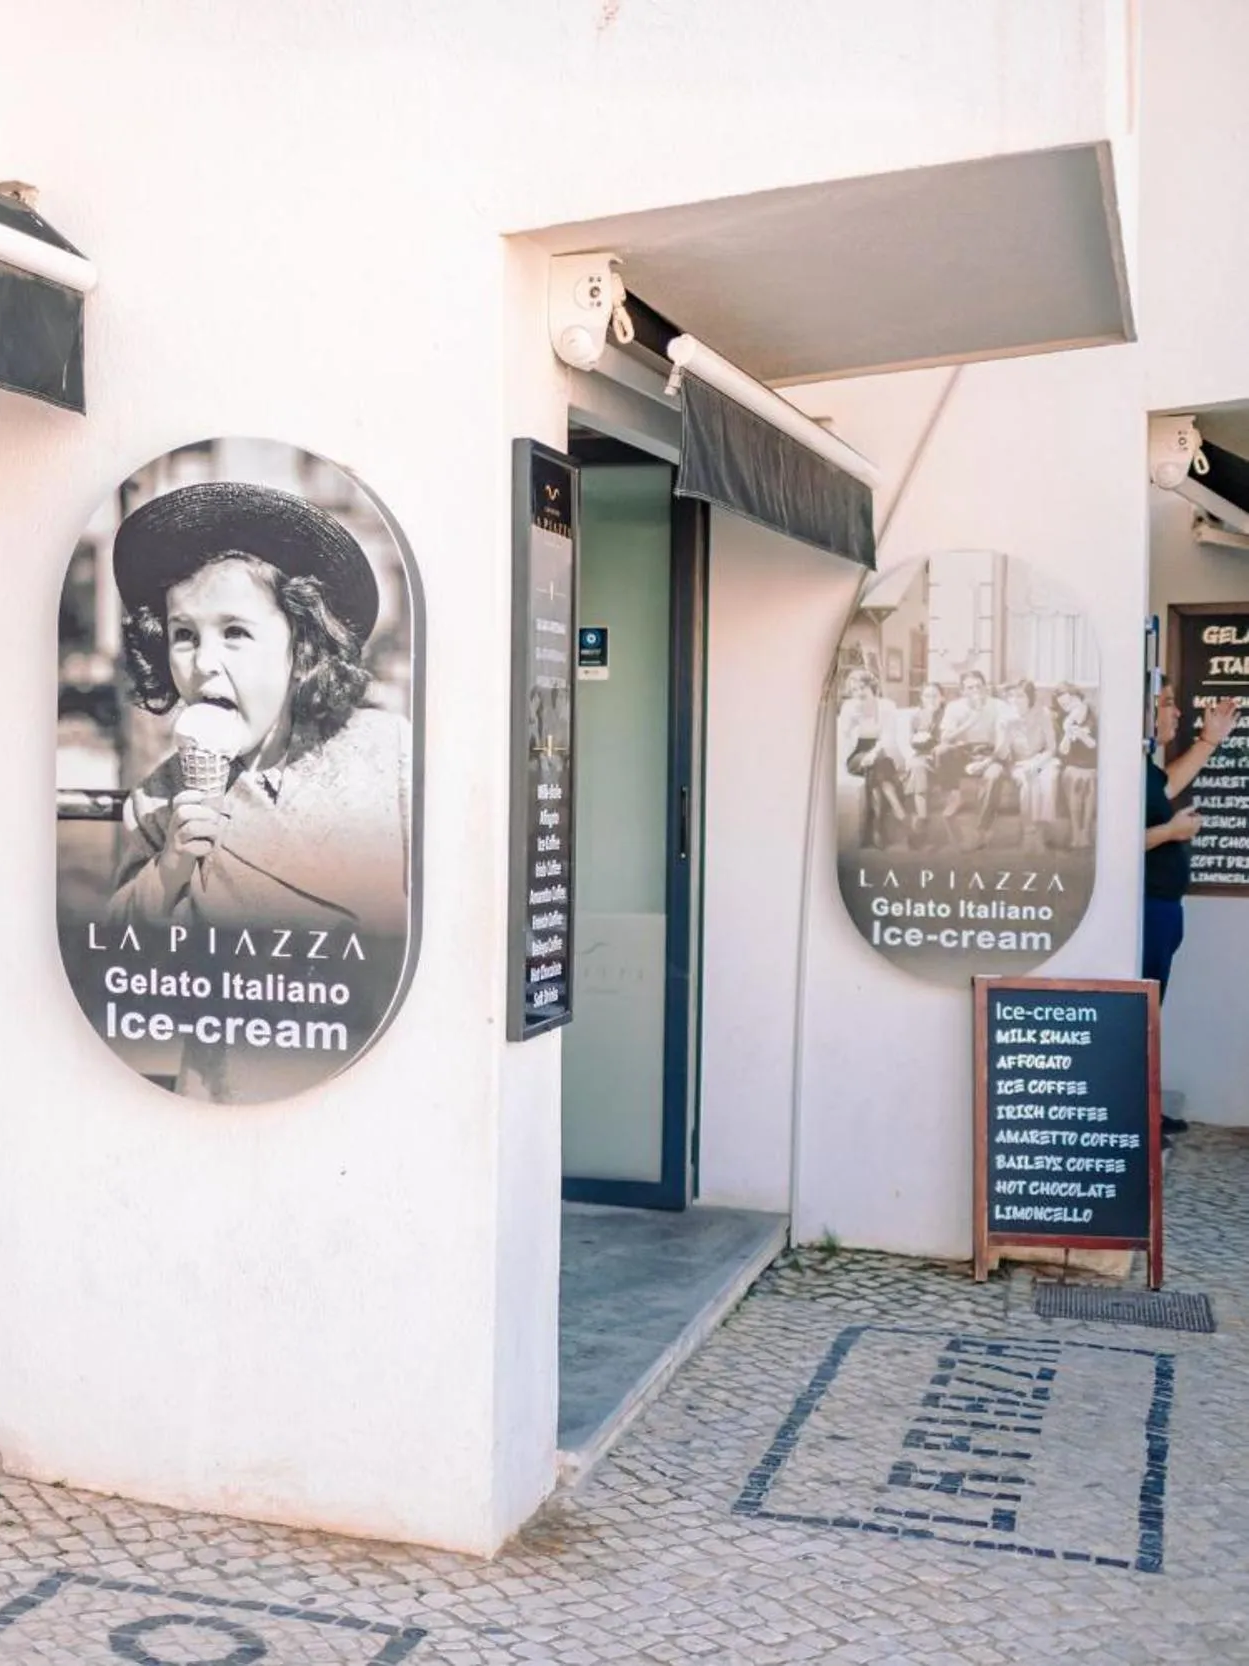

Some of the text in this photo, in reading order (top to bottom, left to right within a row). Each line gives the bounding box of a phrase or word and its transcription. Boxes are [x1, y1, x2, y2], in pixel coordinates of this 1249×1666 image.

[1202, 814, 1247, 829] RENCH
[858, 868, 1065, 892] LA PIAZZA
[871, 896, 1053, 921] Gelato Italiano
[88, 922, 367, 960] LA PIAZZA
[872, 919, 1052, 951] Ice-cream
[104, 965, 351, 1005] Gelato Italiano
[996, 1001, 1097, 1022] Ice-cream
[106, 1002, 348, 1051] Ice-cream
[995, 1029, 1092, 1046] MILK SHAKE
[996, 1054, 1072, 1070] AFFOGATO
[996, 1079, 1088, 1096] ICE COFFEE
[996, 1104, 1108, 1122] IRISH COFFEE
[995, 1130, 1140, 1149] AMARETTO COFFEE
[995, 1154, 1127, 1174] BAILEYS COFFEE
[995, 1180, 1116, 1199] HOT CHOCOLATE
[995, 1205, 1093, 1224] LIMONCELLO
